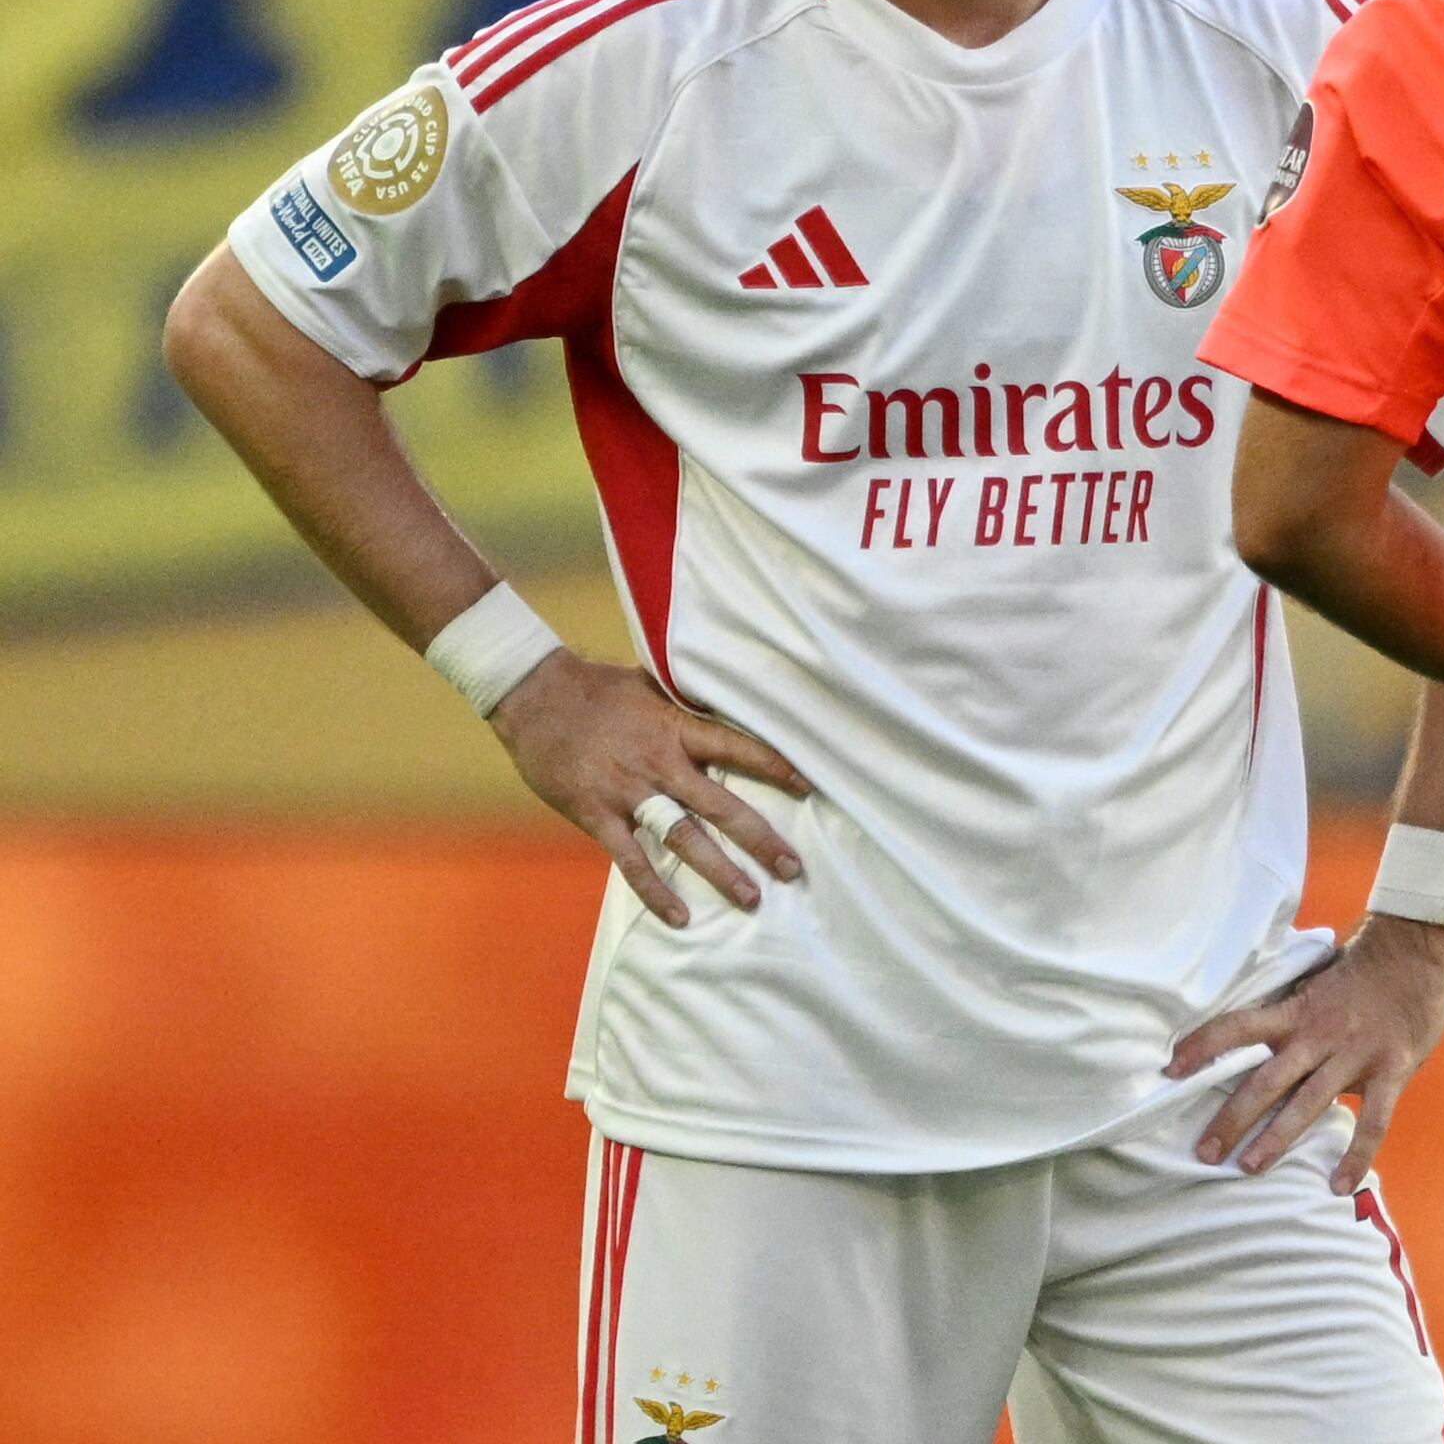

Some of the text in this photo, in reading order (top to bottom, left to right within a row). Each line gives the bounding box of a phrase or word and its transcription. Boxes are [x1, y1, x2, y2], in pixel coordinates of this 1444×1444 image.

[425, 120, 438, 156] CUP
[335, 150, 365, 198] FIFA
[375, 180, 409, 199] USA
[411, 161, 429, 188] 25
[277, 200, 312, 244] World
[304, 238, 331, 269] FIFA
[312, 215, 348, 257] UNITES
[796, 363, 1216, 463] Emirates
[860, 469, 1154, 549] FLY BETTER
